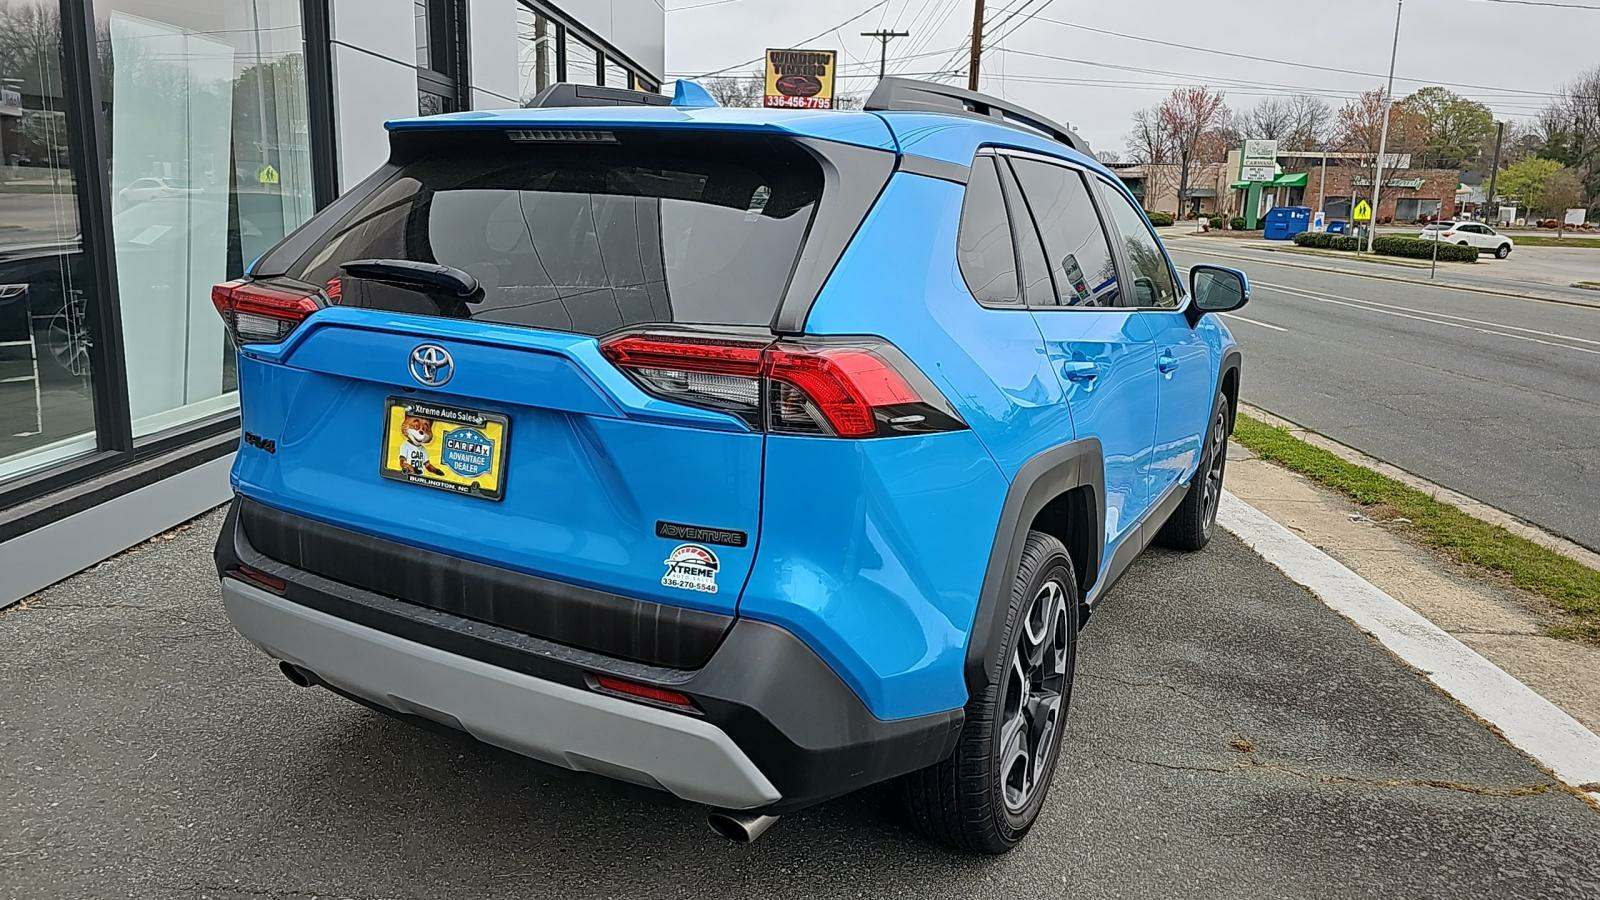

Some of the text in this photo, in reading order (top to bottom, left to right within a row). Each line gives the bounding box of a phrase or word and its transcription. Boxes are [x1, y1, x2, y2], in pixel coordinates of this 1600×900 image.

[767, 95, 830, 108] 336-456-7795
[415, 404, 476, 423] Xtreme Auto Sales
[410, 450, 424, 460] CAR
[447, 440, 490, 456] CARFAX
[448, 451, 486, 466] ADVANTAGE
[453, 461, 478, 474] DEALER
[457, 485, 469, 493] NC
[660, 523, 741, 544] ADVENTURE
[666, 563, 713, 578] XTREME
[663, 578, 716, 592] 336-270-5548
